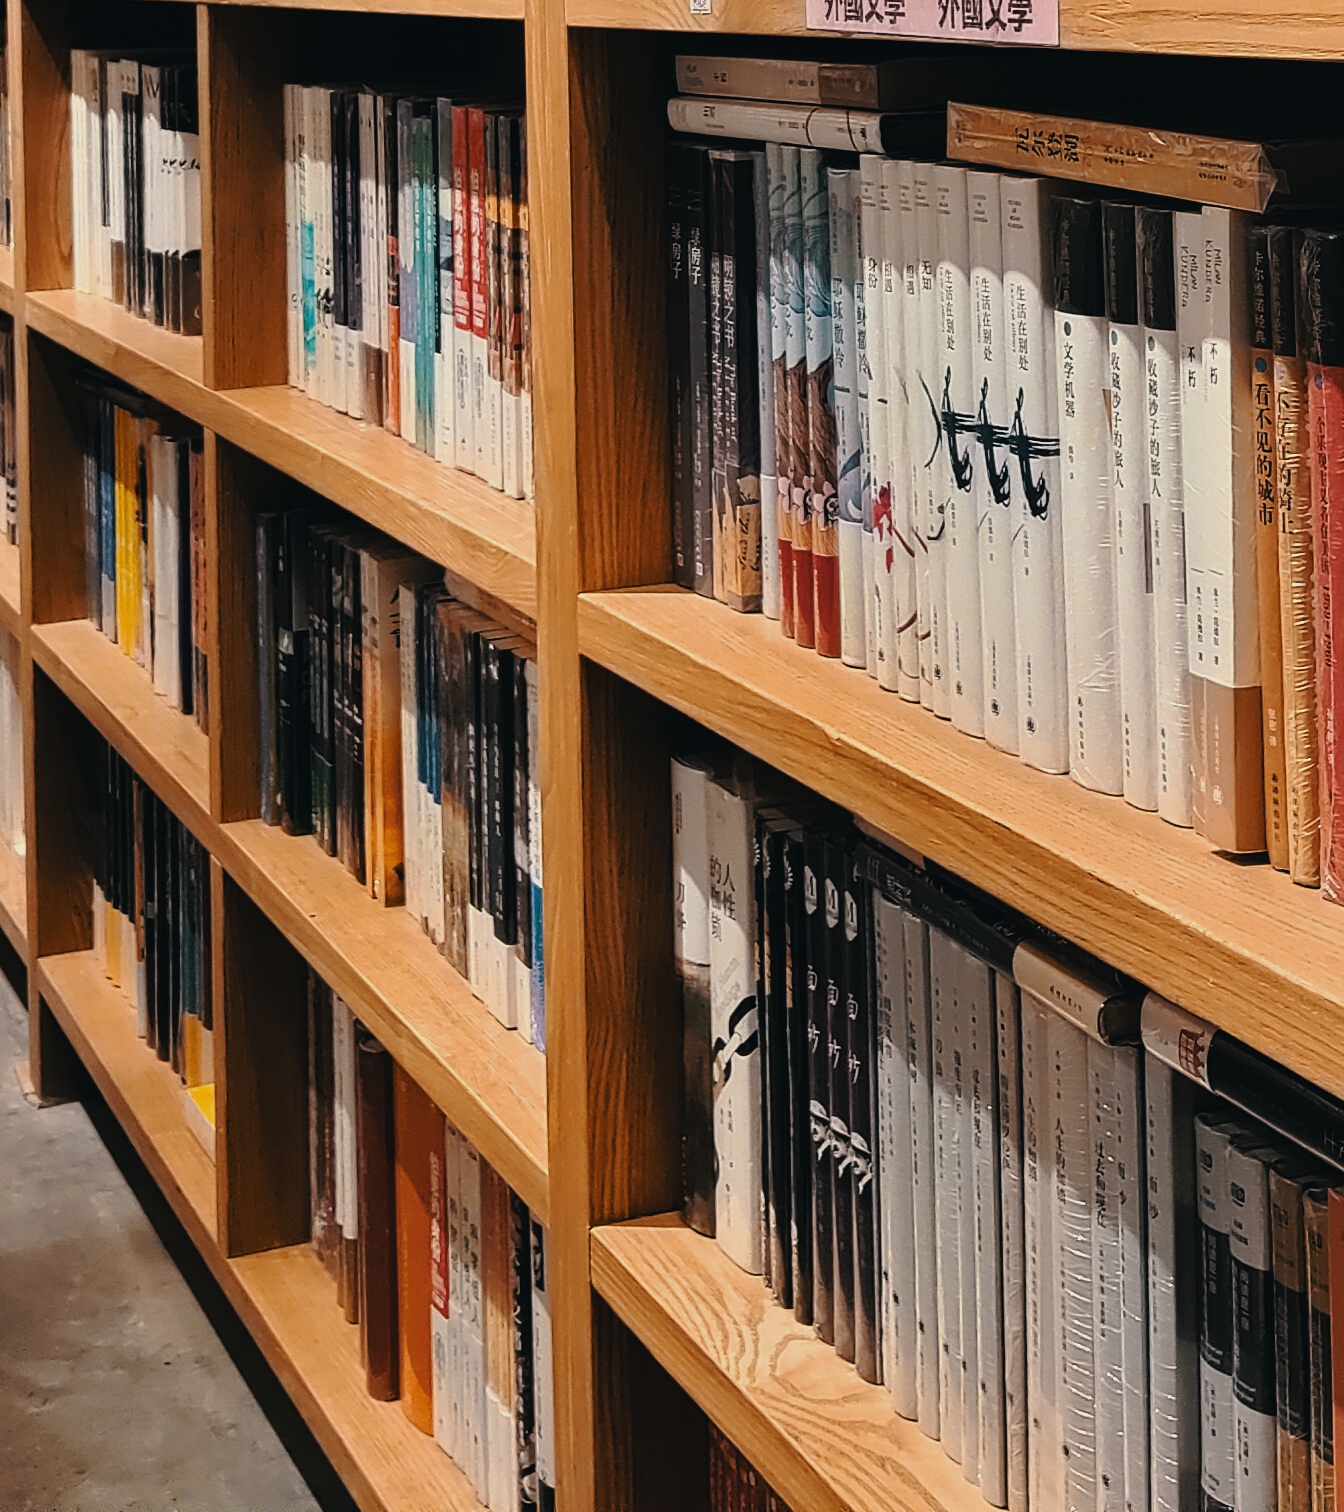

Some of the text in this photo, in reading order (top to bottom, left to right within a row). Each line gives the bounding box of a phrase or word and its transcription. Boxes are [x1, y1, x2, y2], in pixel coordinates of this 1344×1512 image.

[1014, 126, 1082, 164] 瓦尔登湖
[689, 227, 702, 285] 绿房子
[867, 257, 879, 289] 身份
[920, 259, 933, 291] 无知
[1179, 245, 1189, 308] KUNDERA
[1189, 254, 1199, 290] MILAN
[1204, 239, 1213, 303] KUNDERA
[1212, 248, 1222, 286] MILAN
[944, 268, 956, 352] 生活在别处
[981, 276, 993, 362] 生活在别处
[1016, 284, 1029, 372] 生活在别处
[1063, 341, 1076, 419] 文学机器
[1186, 345, 1198, 389] 不朽
[1110, 350, 1125, 488] 收藏沙子的旅人
[1147, 358, 1162, 498] 收藏沙子的旅人
[1254, 382, 1275, 527] 看不见的城市
[721, 860, 737, 922] 人性
